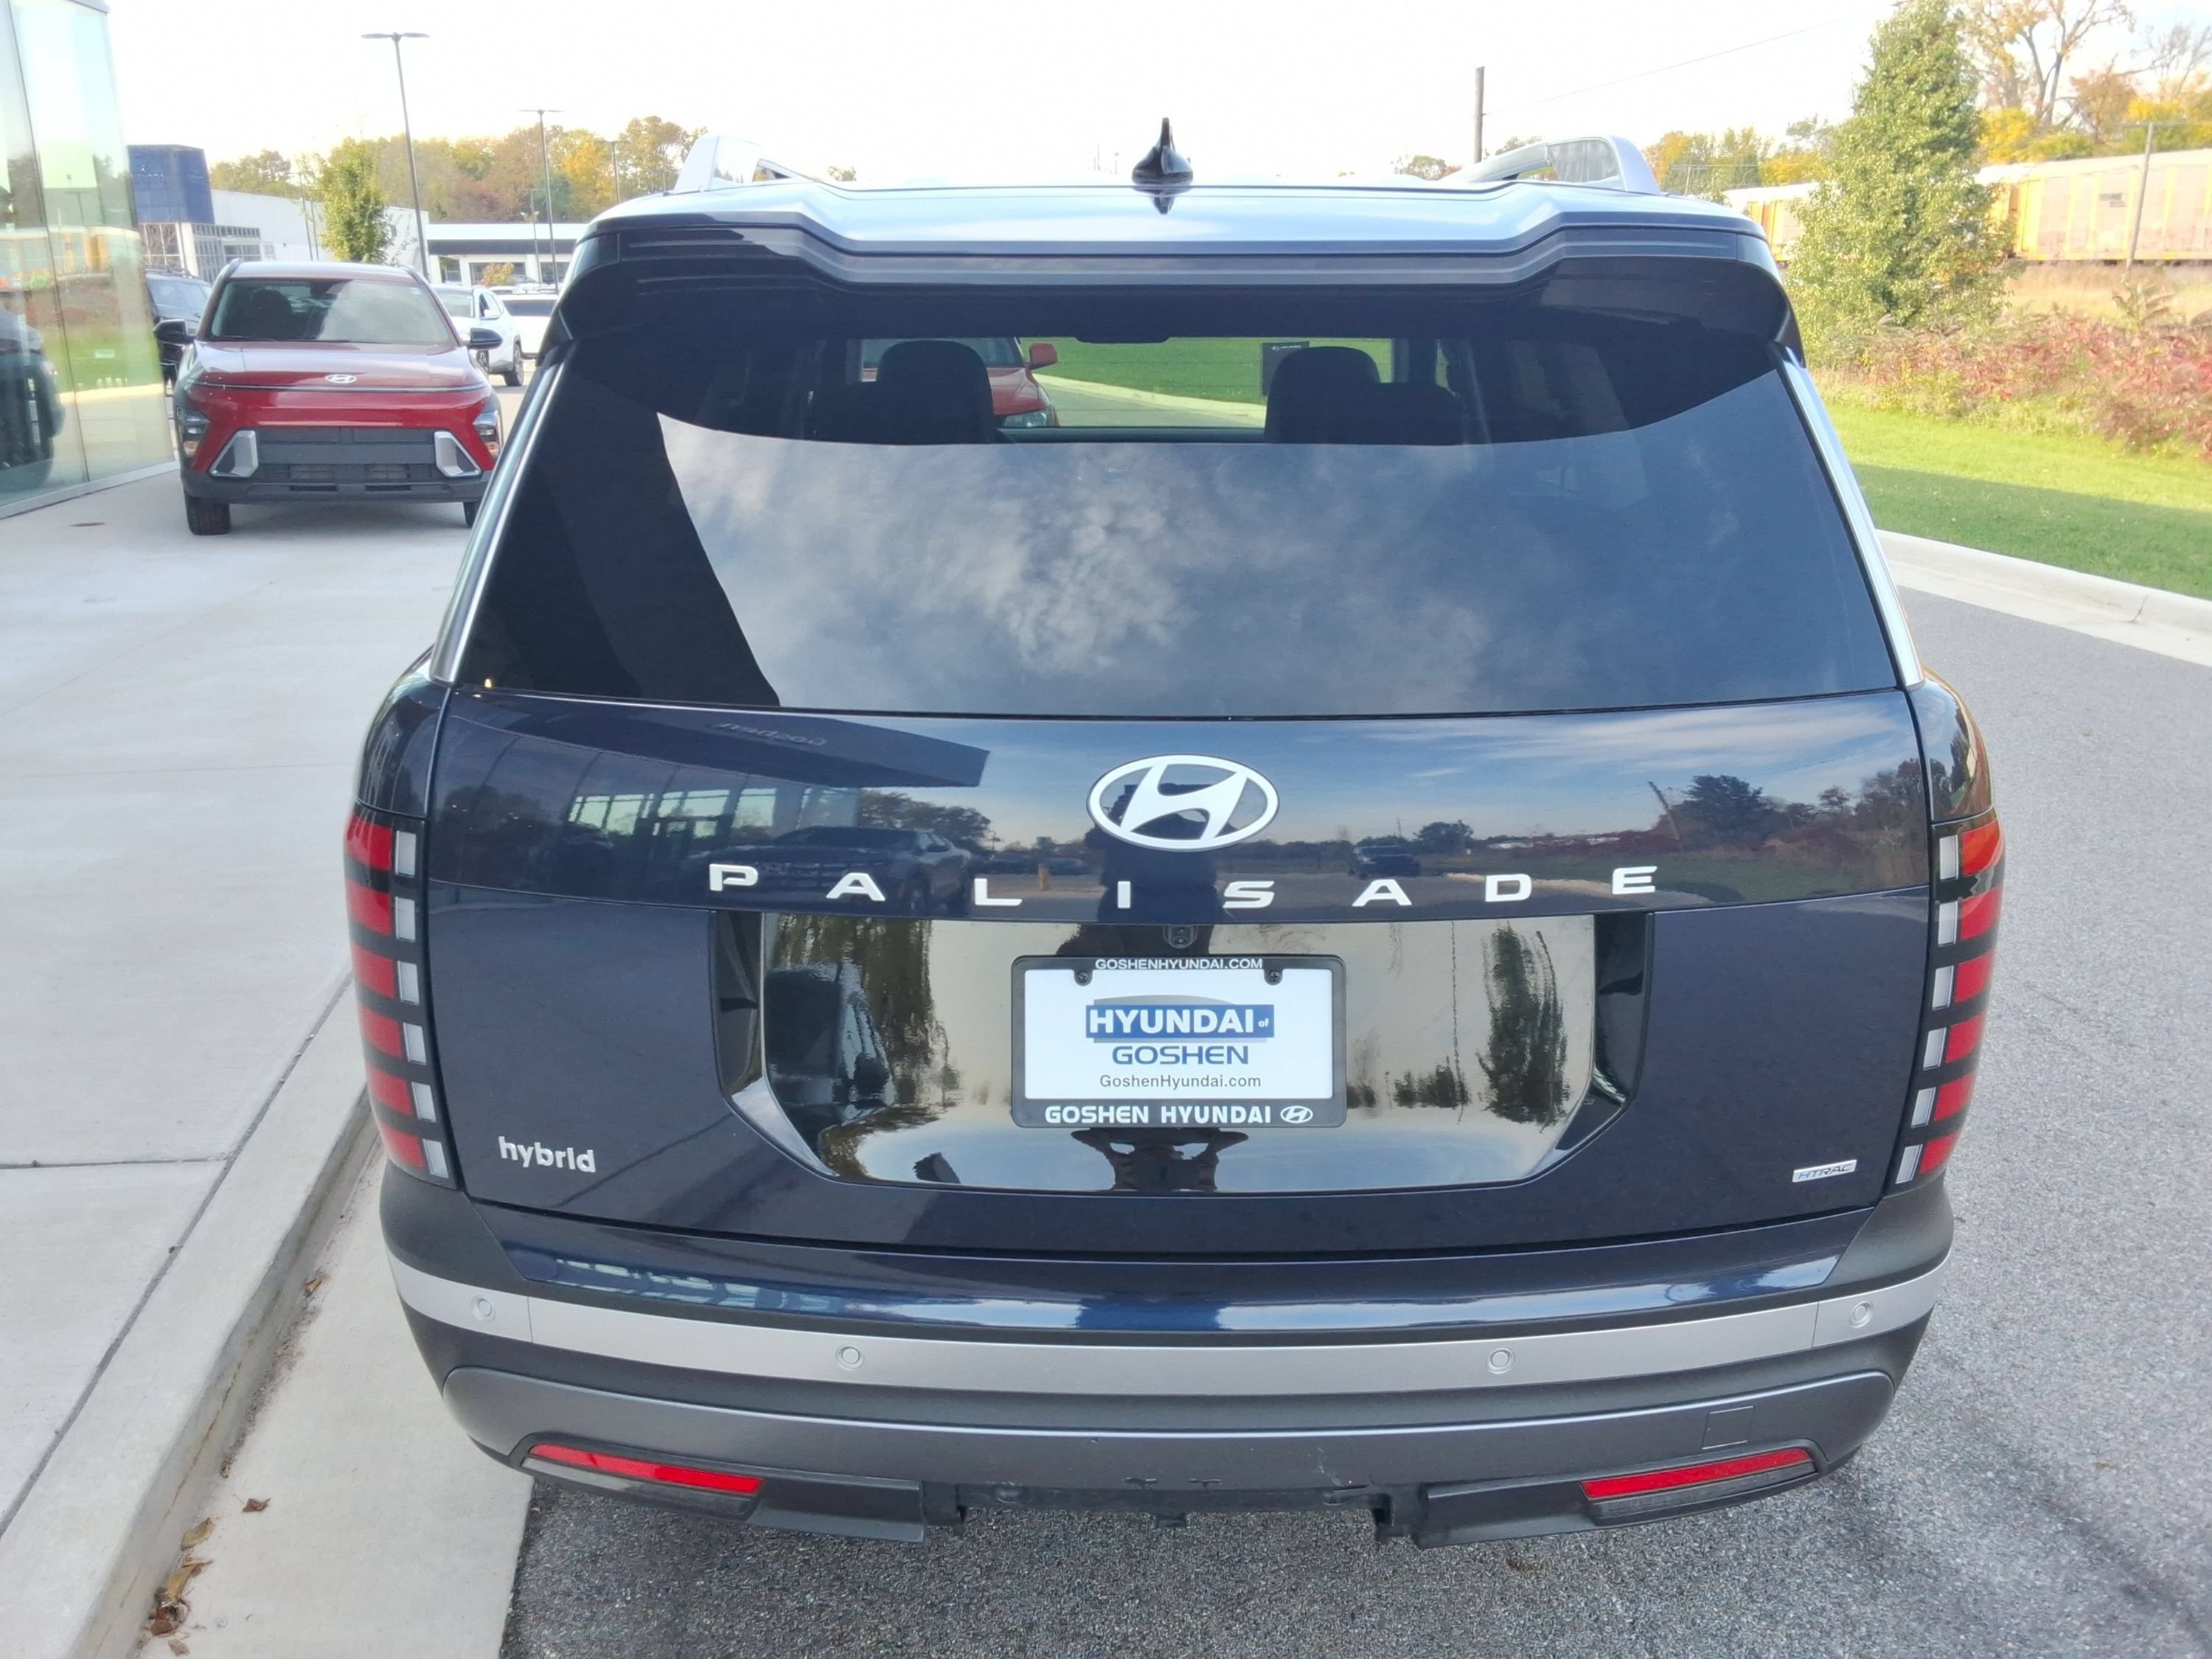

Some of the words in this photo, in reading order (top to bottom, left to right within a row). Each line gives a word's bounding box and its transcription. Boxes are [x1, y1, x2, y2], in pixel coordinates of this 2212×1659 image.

[709, 863, 1658, 909] PALISADE
[1094, 959, 1263, 970] GOSHENHYUNDAI.COM
[1088, 1009, 1253, 1034] HYUNDAI
[1257, 1018, 1270, 1028] of
[1112, 1045, 1249, 1065] GOSHEN
[1099, 1074, 1262, 1091] GoshenHyundai.com
[1045, 1105, 1150, 1124] GOSHEN
[1161, 1105, 1271, 1124] HYUNDAI
[498, 1135, 597, 1173] hybrid
[1797, 1162, 1853, 1181] HTRAC
